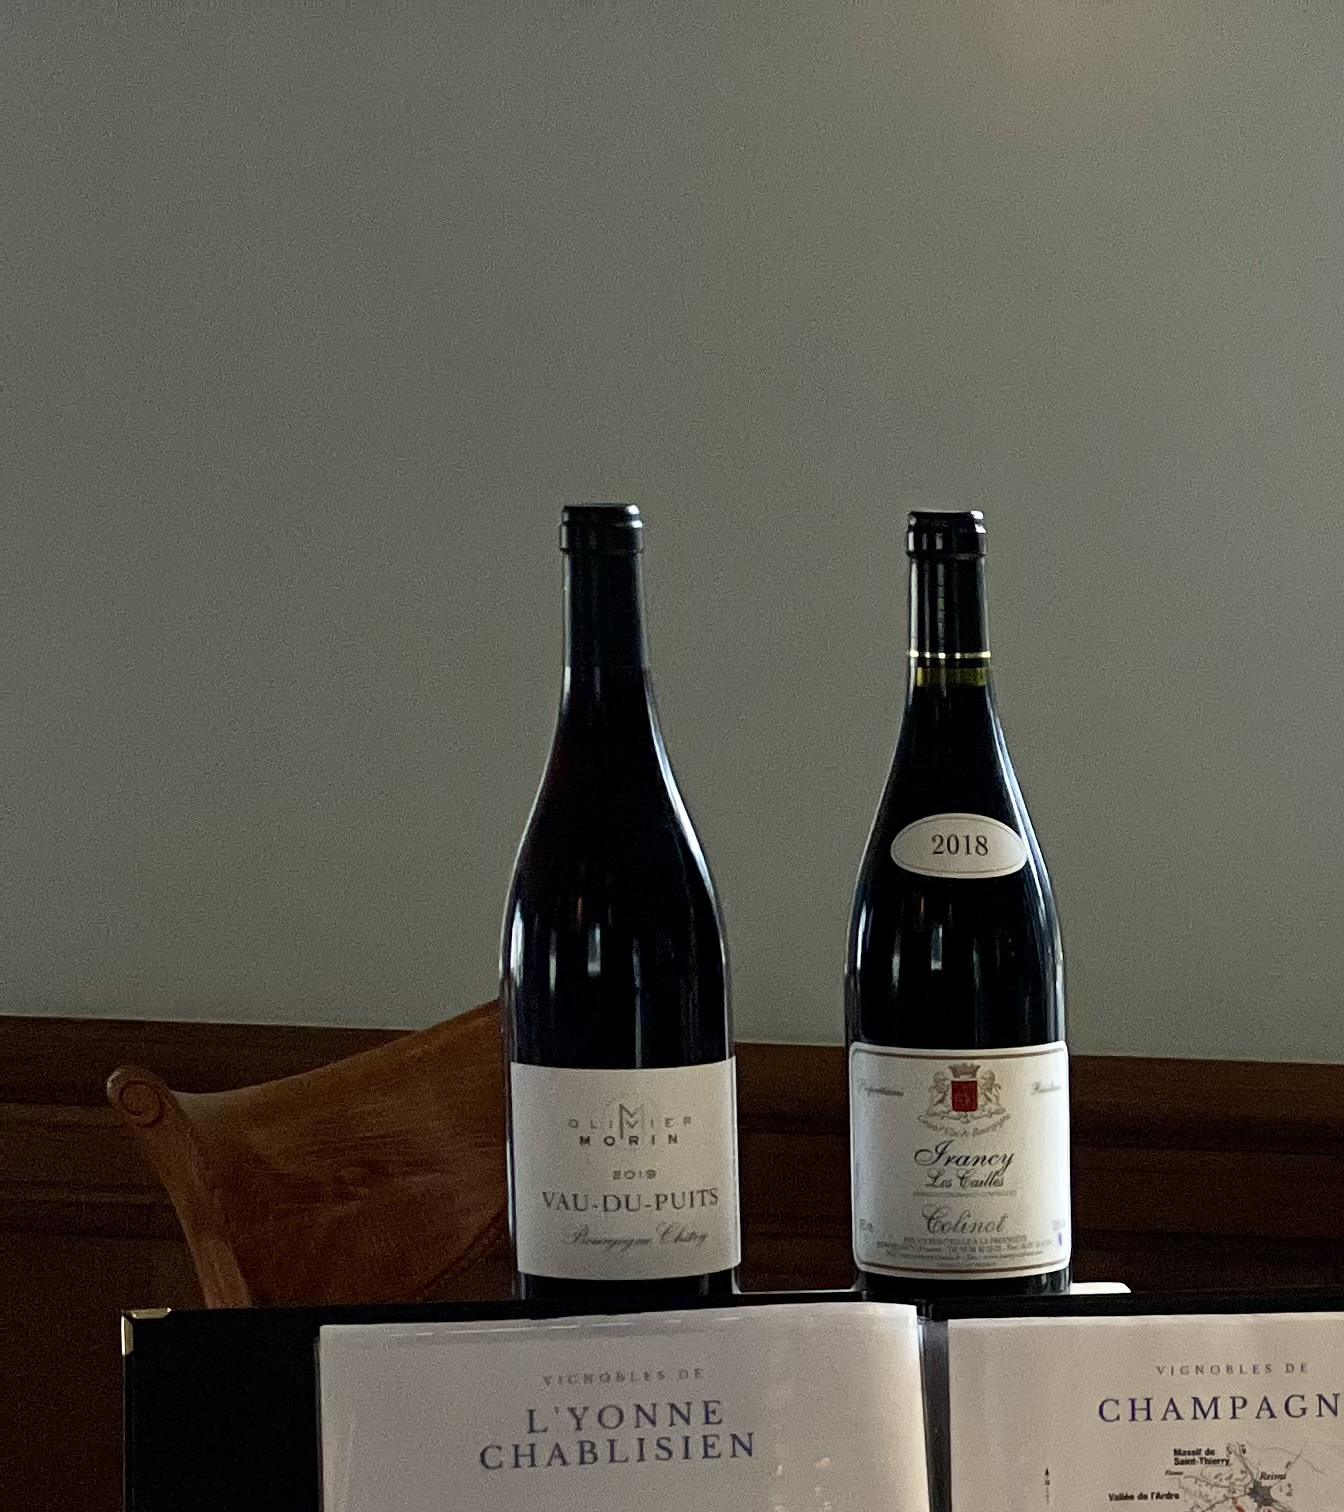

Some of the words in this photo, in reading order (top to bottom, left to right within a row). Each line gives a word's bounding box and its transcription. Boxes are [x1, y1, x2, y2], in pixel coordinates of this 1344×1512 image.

[931, 834, 989, 856] 2018
[569, 1114, 692, 1131] OLIVIER
[579, 1133, 679, 1147] MORIN
[914, 1139, 1015, 1176] Irancy
[542, 1188, 719, 1213] VAU-DU-PUITS
[921, 1203, 1009, 1235] Colinot
[543, 1369, 667, 1386] VIGNOBLES
[678, 1367, 705, 1381] DE
[1156, 1363, 1274, 1376] VIGNOBLES
[1285, 1361, 1309, 1374] DE
[526, 1400, 724, 1434] L'YONNE
[479, 1431, 756, 1470] CHABLISIEN
[1173, 1448, 1201, 1457] Massif
[1204, 1448, 1215, 1457] de
[1173, 1456, 1231, 1467] Saint-Thierry
[1107, 1491, 1136, 1502] Vallée
[1137, 1491, 1149, 1501] de
